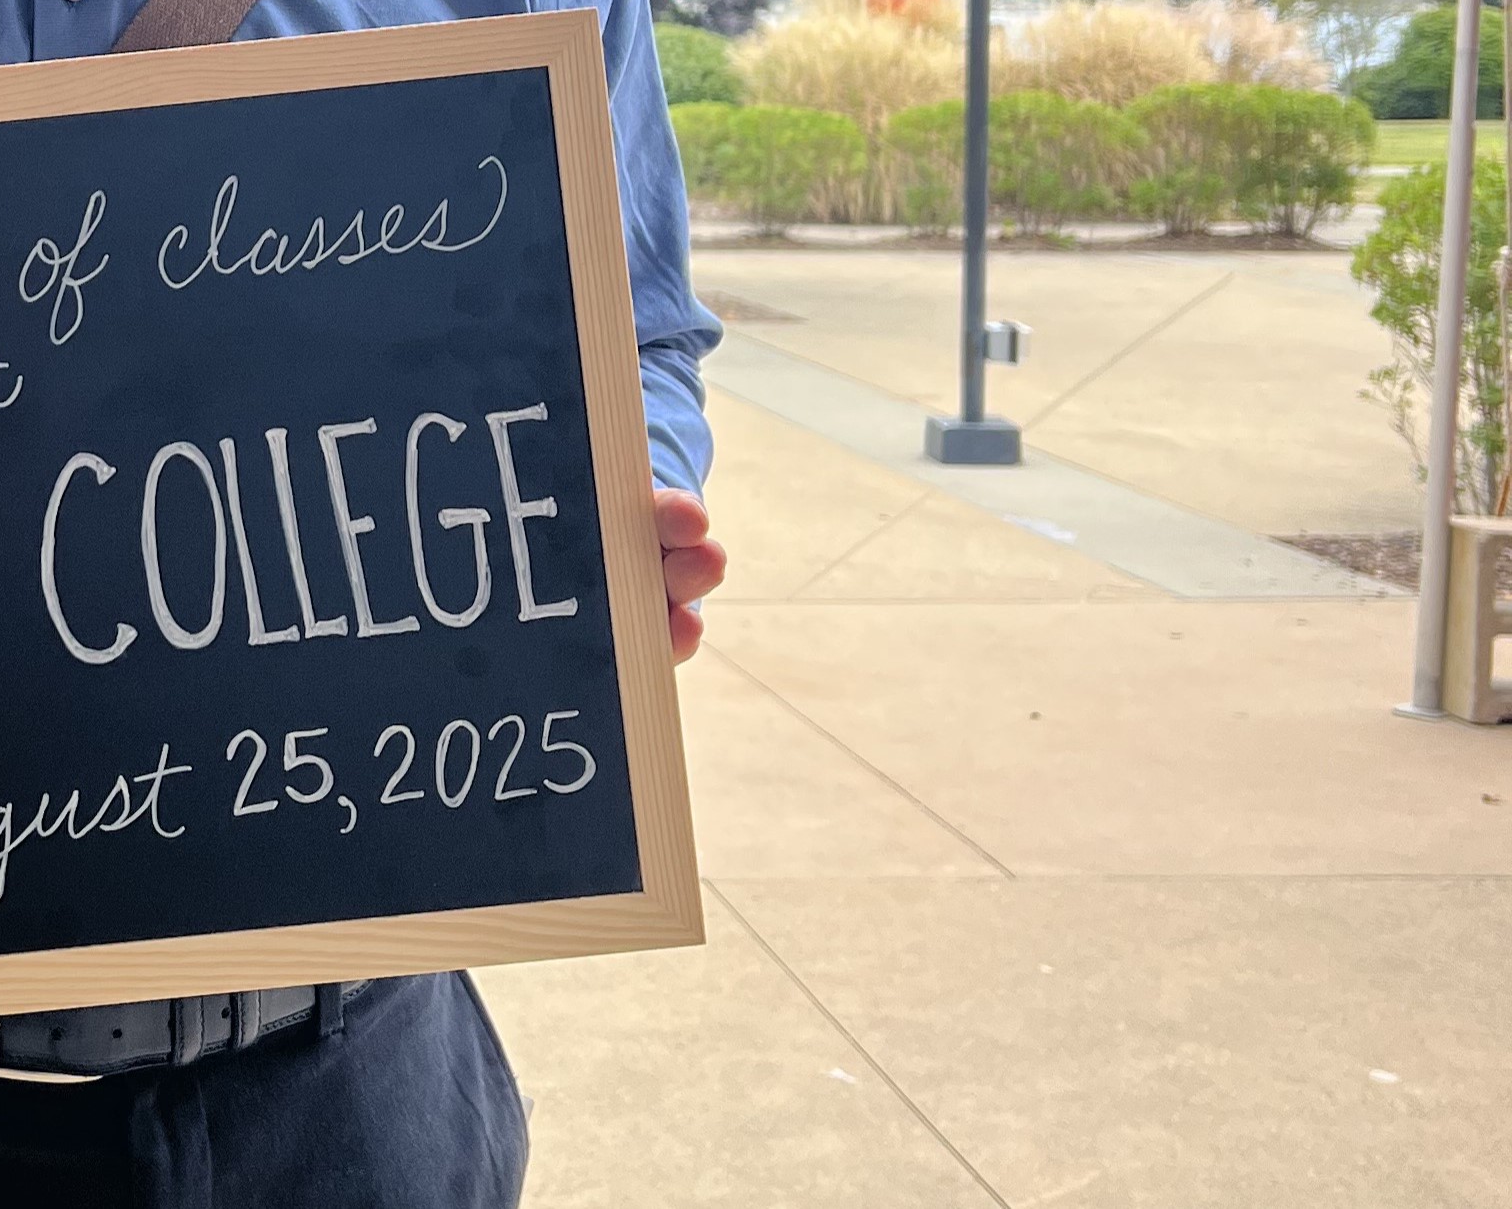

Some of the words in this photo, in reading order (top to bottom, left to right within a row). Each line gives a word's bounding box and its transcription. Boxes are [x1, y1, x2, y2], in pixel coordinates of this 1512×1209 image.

[18, 189, 110, 346] of
[158, 155, 508, 290] classes
[40, 401, 579, 665] COLLEGE
[373, 710, 597, 808] 2025
